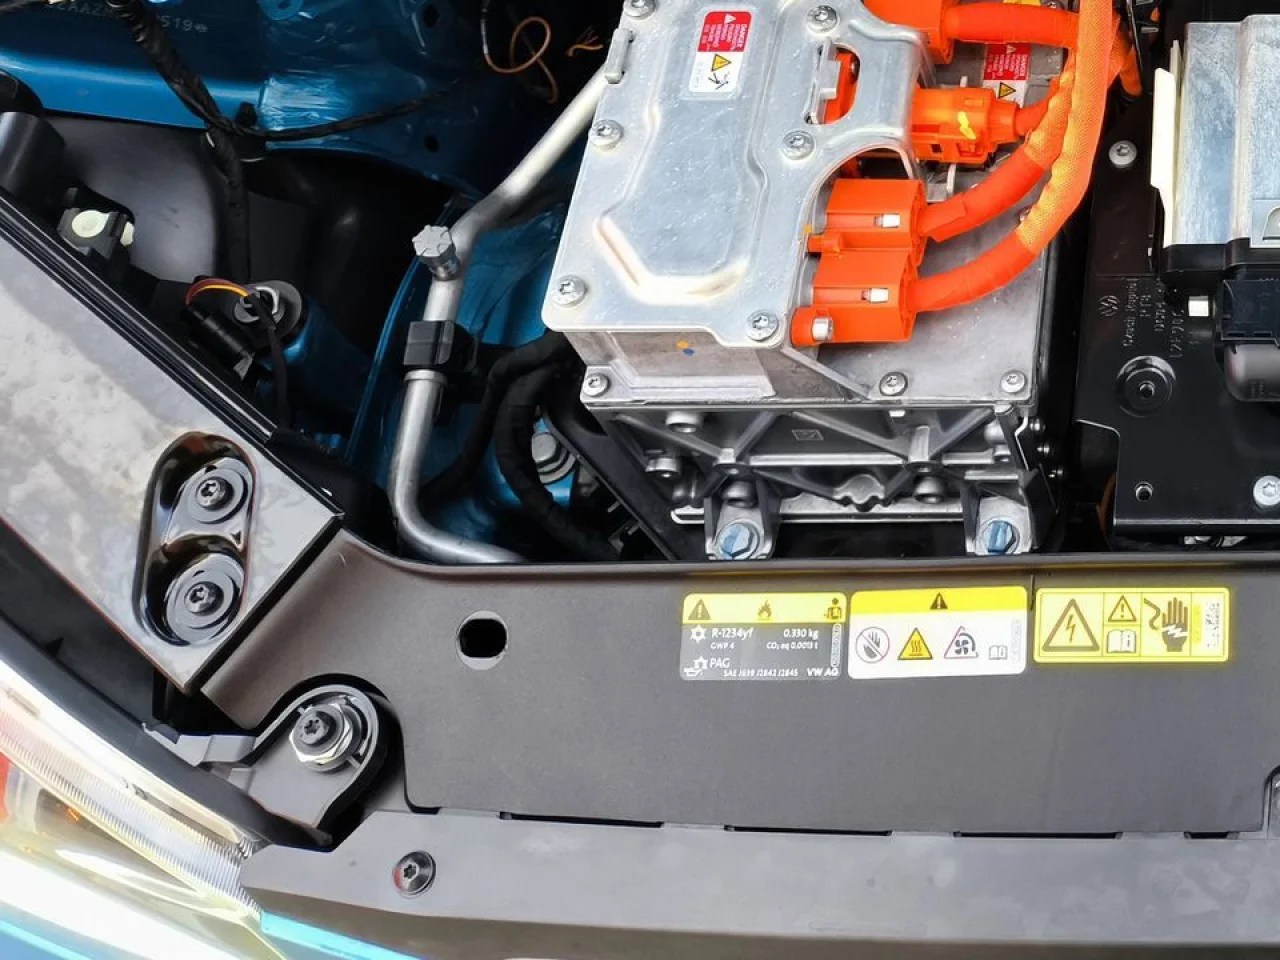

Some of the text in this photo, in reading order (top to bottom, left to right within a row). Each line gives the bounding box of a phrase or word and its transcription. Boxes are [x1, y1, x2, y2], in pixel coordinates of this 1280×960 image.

[711, 627, 755, 641] R-1234yf
[808, 628, 820, 640] kg
[710, 657, 731, 668] PAG
[806, 667, 823, 677] VW
[823, 667, 840, 677] AG
